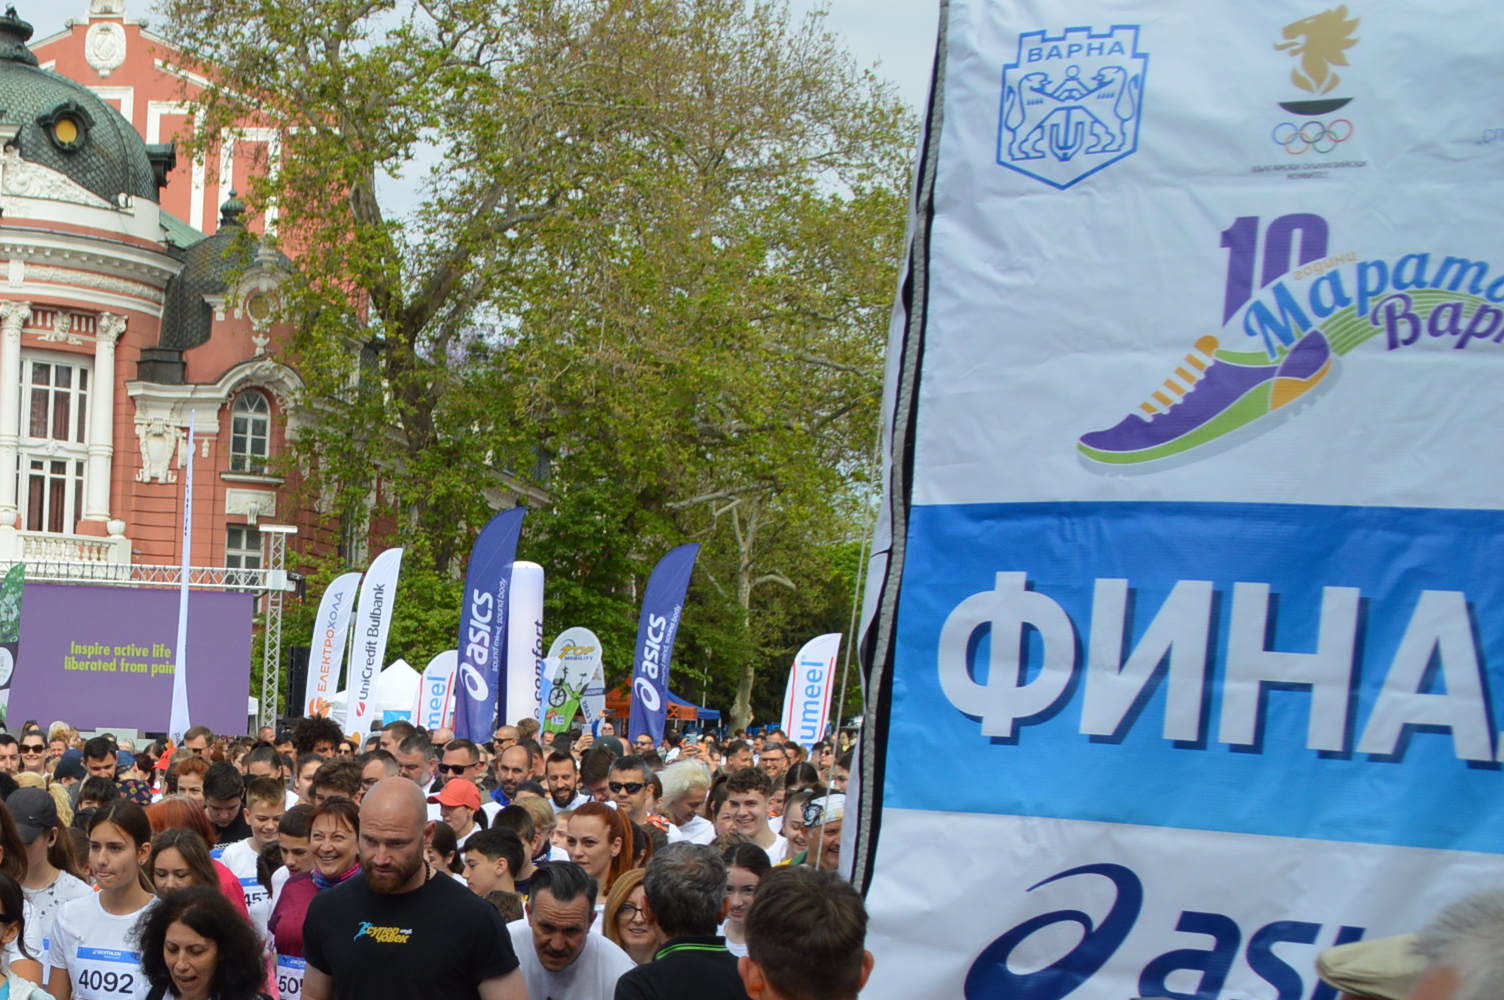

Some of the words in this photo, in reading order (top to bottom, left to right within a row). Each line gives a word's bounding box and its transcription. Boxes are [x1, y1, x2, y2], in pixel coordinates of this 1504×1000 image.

[1026, 39, 1127, 64] ВАРНА
[1219, 212, 1329, 328] 10
[1243, 252, 1504, 363] Марато
[1370, 293, 1504, 350] Вар
[367, 583, 386, 638] Bulbank
[466, 588, 494, 666] asics
[64, 655, 117, 672] liberated
[120, 658, 148, 672] from
[151, 661, 177, 677] pain
[71, 641, 111, 659] Inspire
[114, 643, 149, 657] active
[152, 643, 172, 657] life
[359, 641, 378, 700] UniCredit
[641, 613, 667, 680] asics
[937, 571, 1504, 767] ФИНА
[800, 660, 824, 749] umeel
[78, 969, 134, 994] 4092
